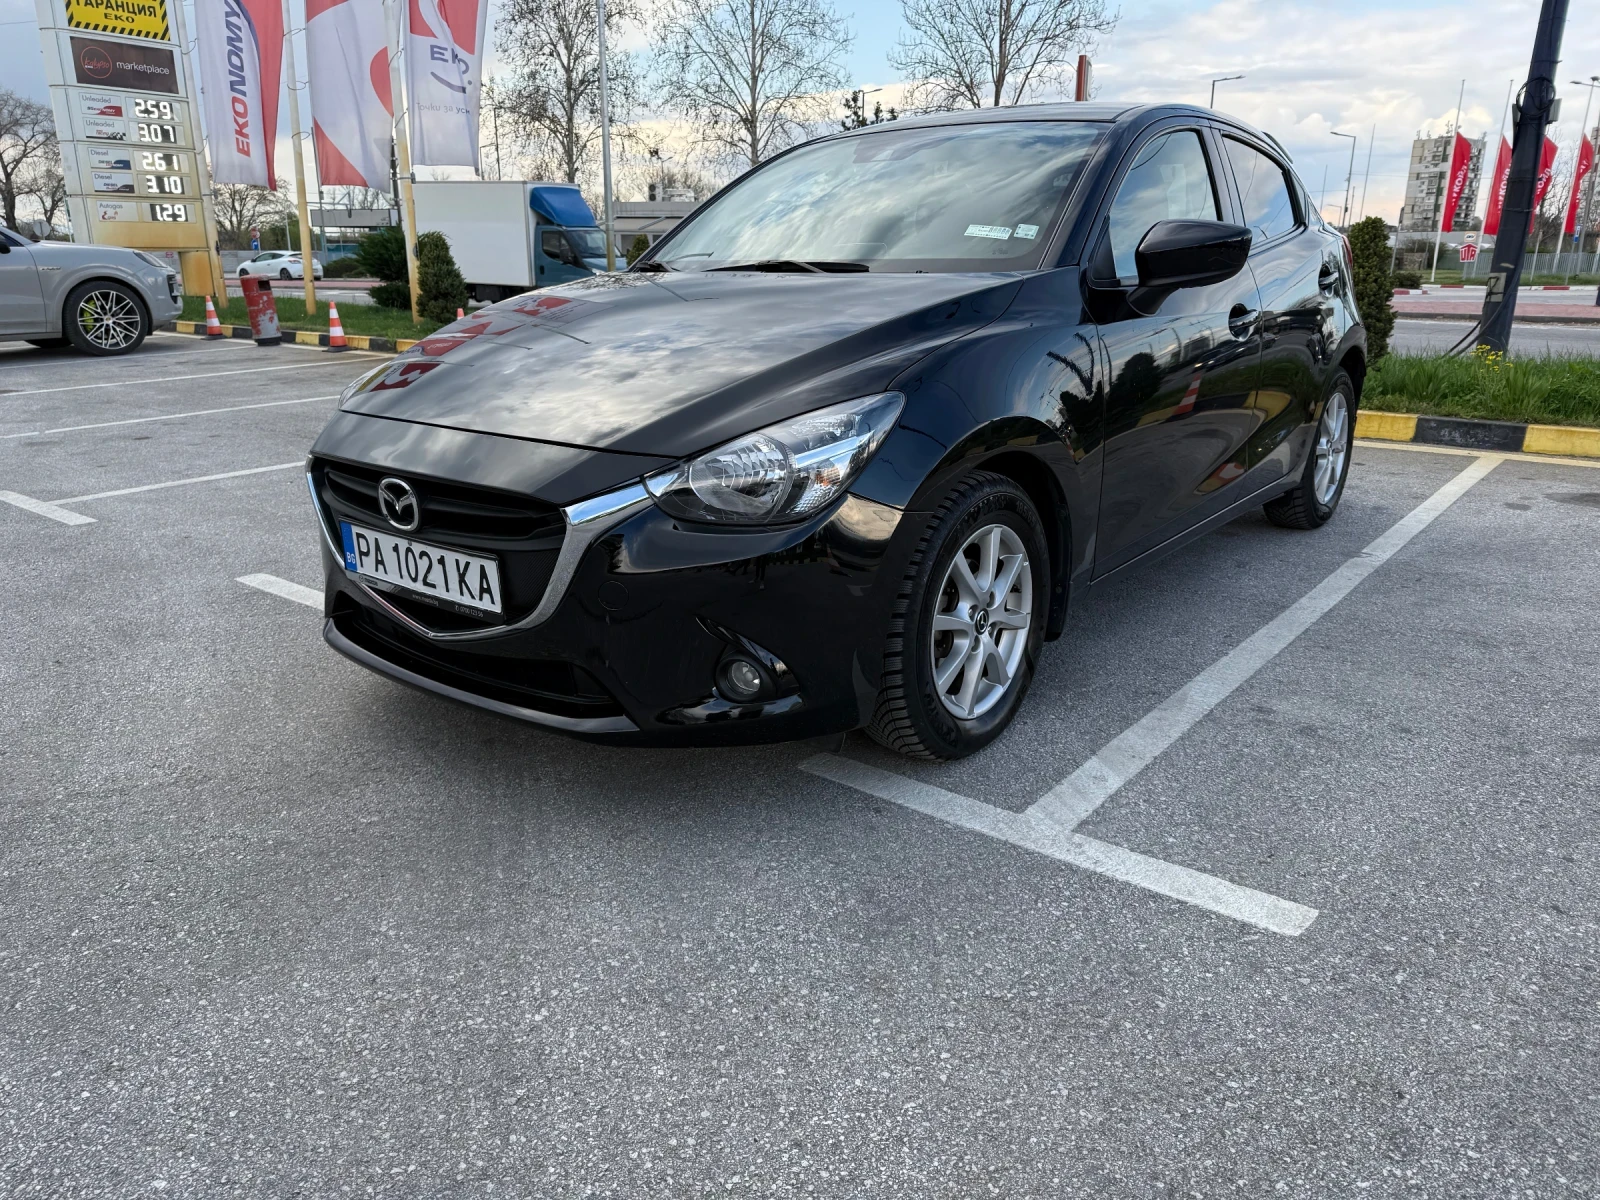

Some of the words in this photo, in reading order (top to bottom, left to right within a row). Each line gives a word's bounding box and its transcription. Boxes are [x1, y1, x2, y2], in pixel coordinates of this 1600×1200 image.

[116, 61, 170, 75] marketplace
[224, 5, 251, 158] EKONOMY
[81, 94, 112, 104] Unleaded
[85, 119, 115, 128] Unleaded
[99, 202, 123, 210] Autogas
[347, 552, 356, 564] BG
